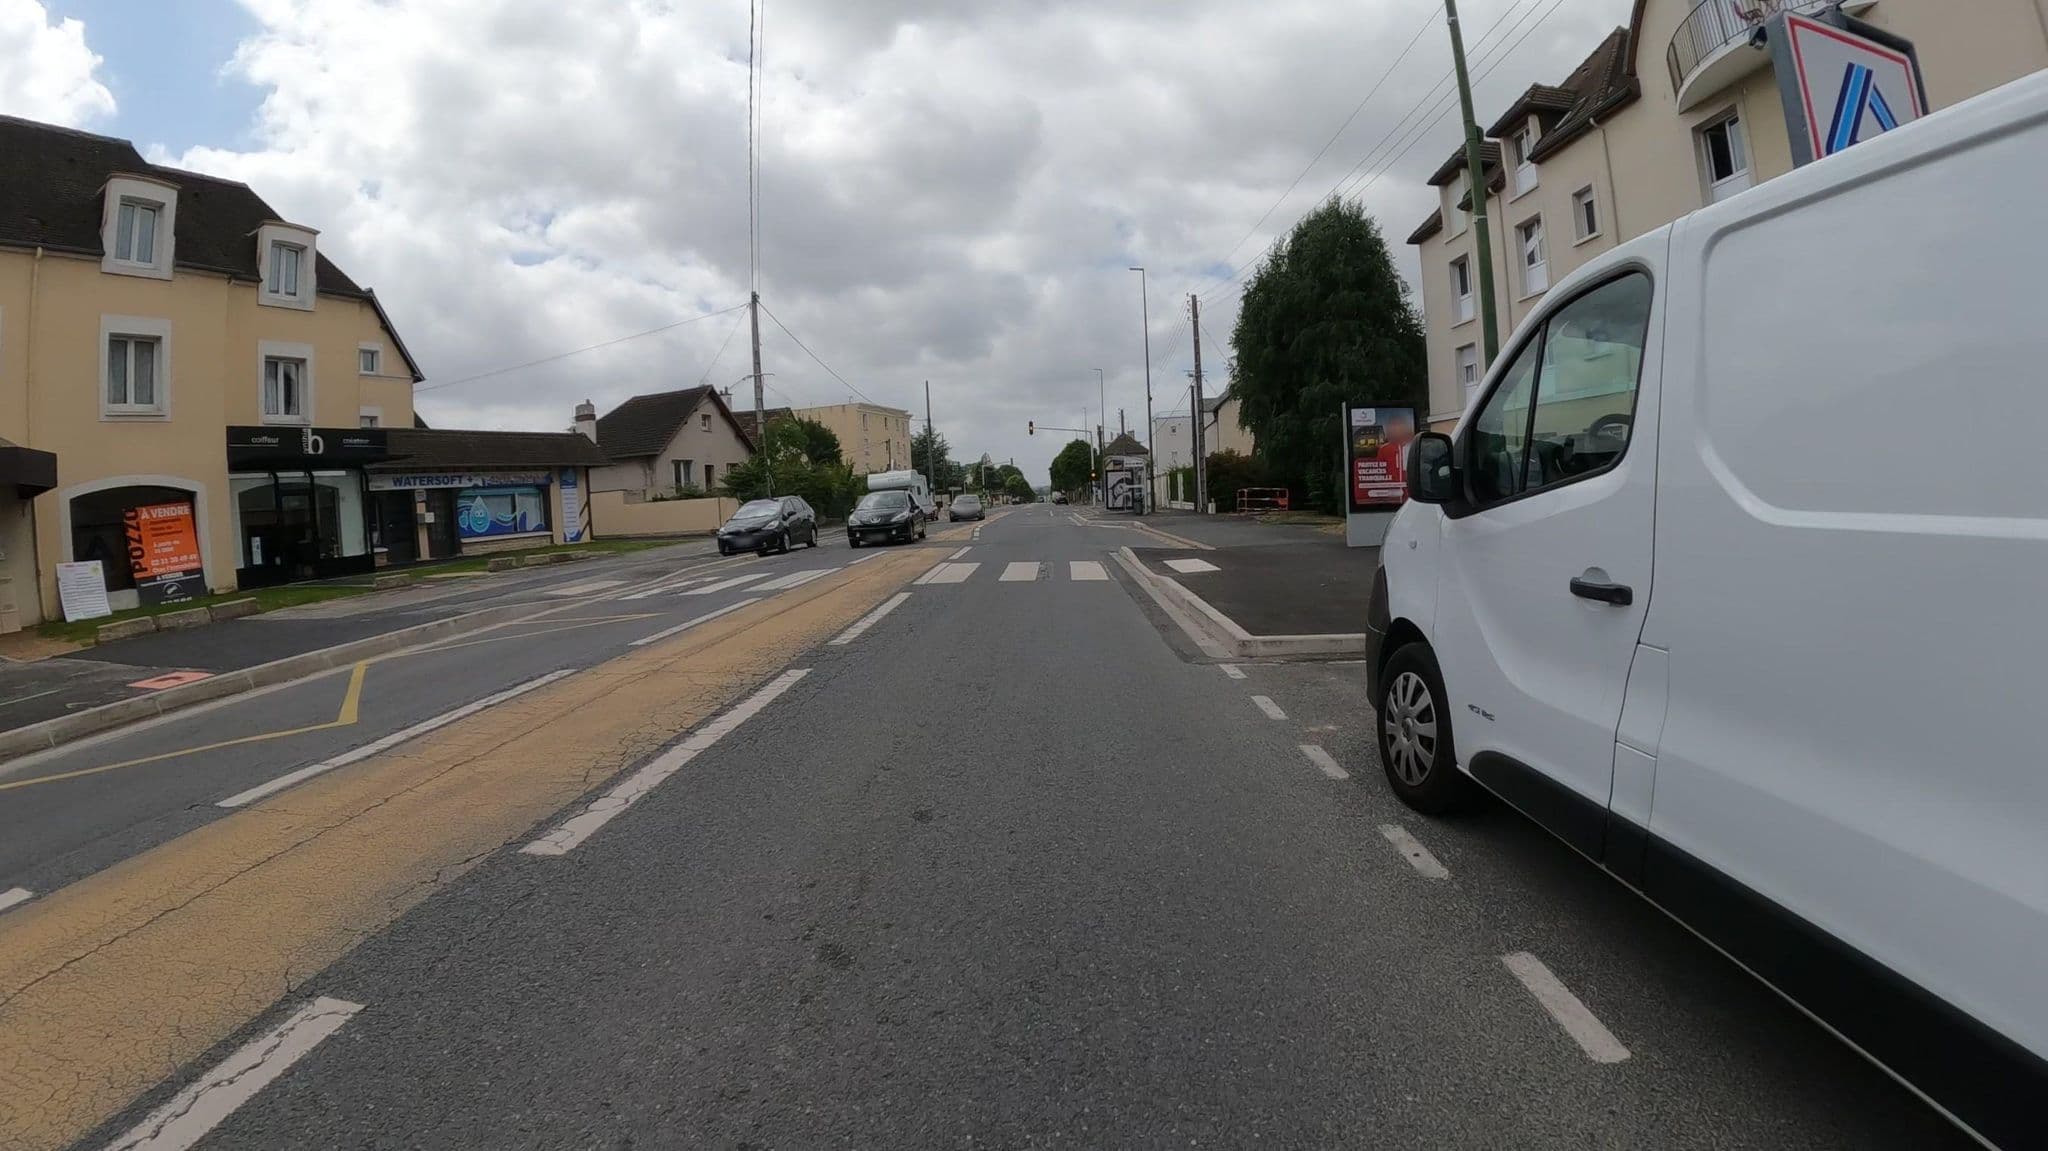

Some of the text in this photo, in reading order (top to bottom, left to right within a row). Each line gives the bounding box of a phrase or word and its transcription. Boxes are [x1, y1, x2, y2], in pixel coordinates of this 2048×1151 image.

[251, 436, 279, 444] coiffeur
[392, 475, 463, 487] WATERSOFT
[150, 505, 192, 519] VENDRE
[123, 507, 148, 573] POZZO
